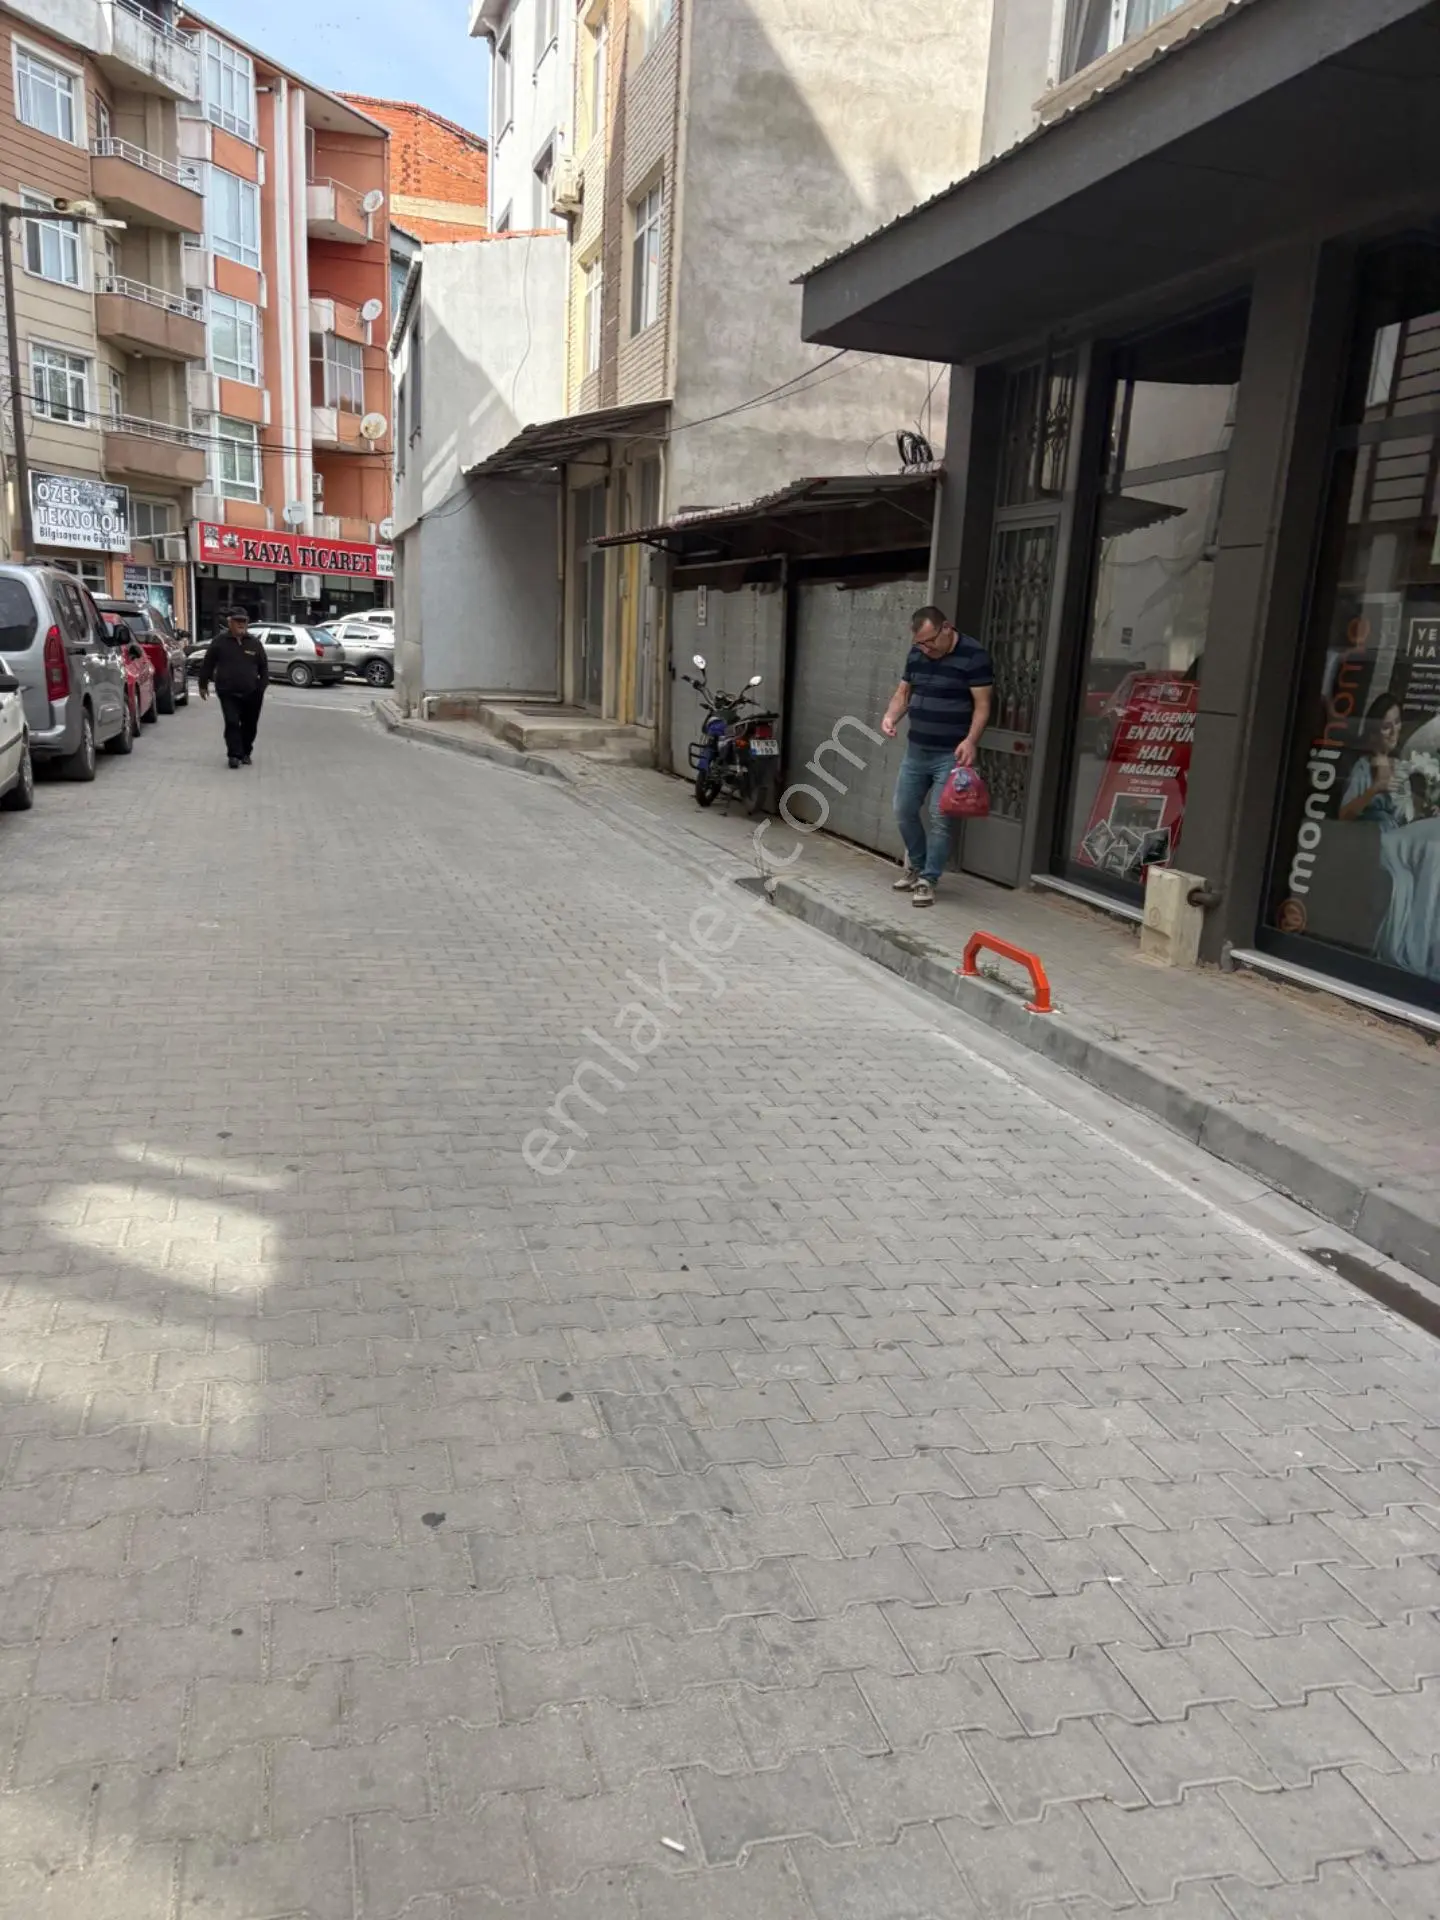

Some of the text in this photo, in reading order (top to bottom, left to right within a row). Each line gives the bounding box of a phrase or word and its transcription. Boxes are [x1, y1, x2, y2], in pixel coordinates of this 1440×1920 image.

[37, 478, 80, 505] ÖZER
[243, 540, 293, 566] KAYA
[298, 543, 373, 573] TİCARET
[1414, 644, 1440, 658] HA
[1126, 725, 1146, 740] EN
[1137, 745, 1174, 761] HALI
